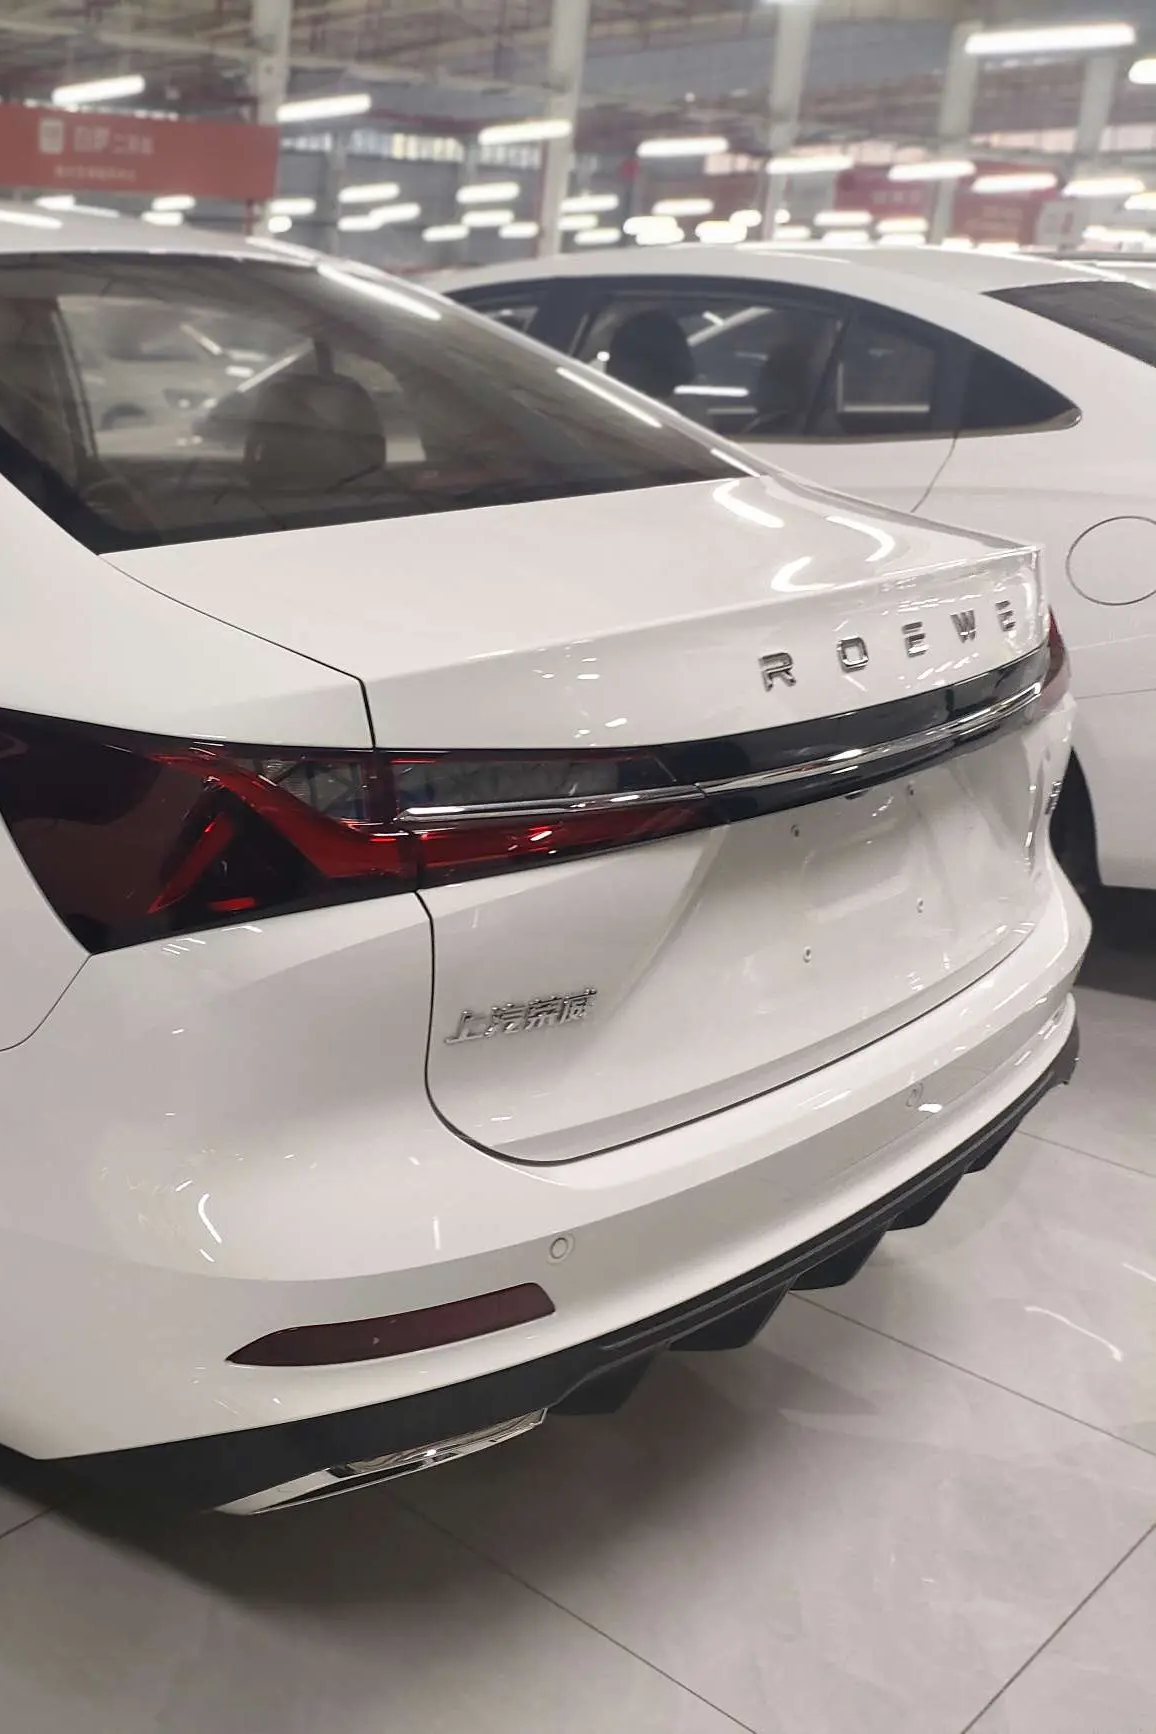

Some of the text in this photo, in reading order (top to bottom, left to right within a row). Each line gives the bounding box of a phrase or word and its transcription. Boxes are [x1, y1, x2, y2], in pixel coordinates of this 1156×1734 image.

[759, 600, 1017, 692] ROEWE
[444, 988, 597, 1044] 上汽荣威
